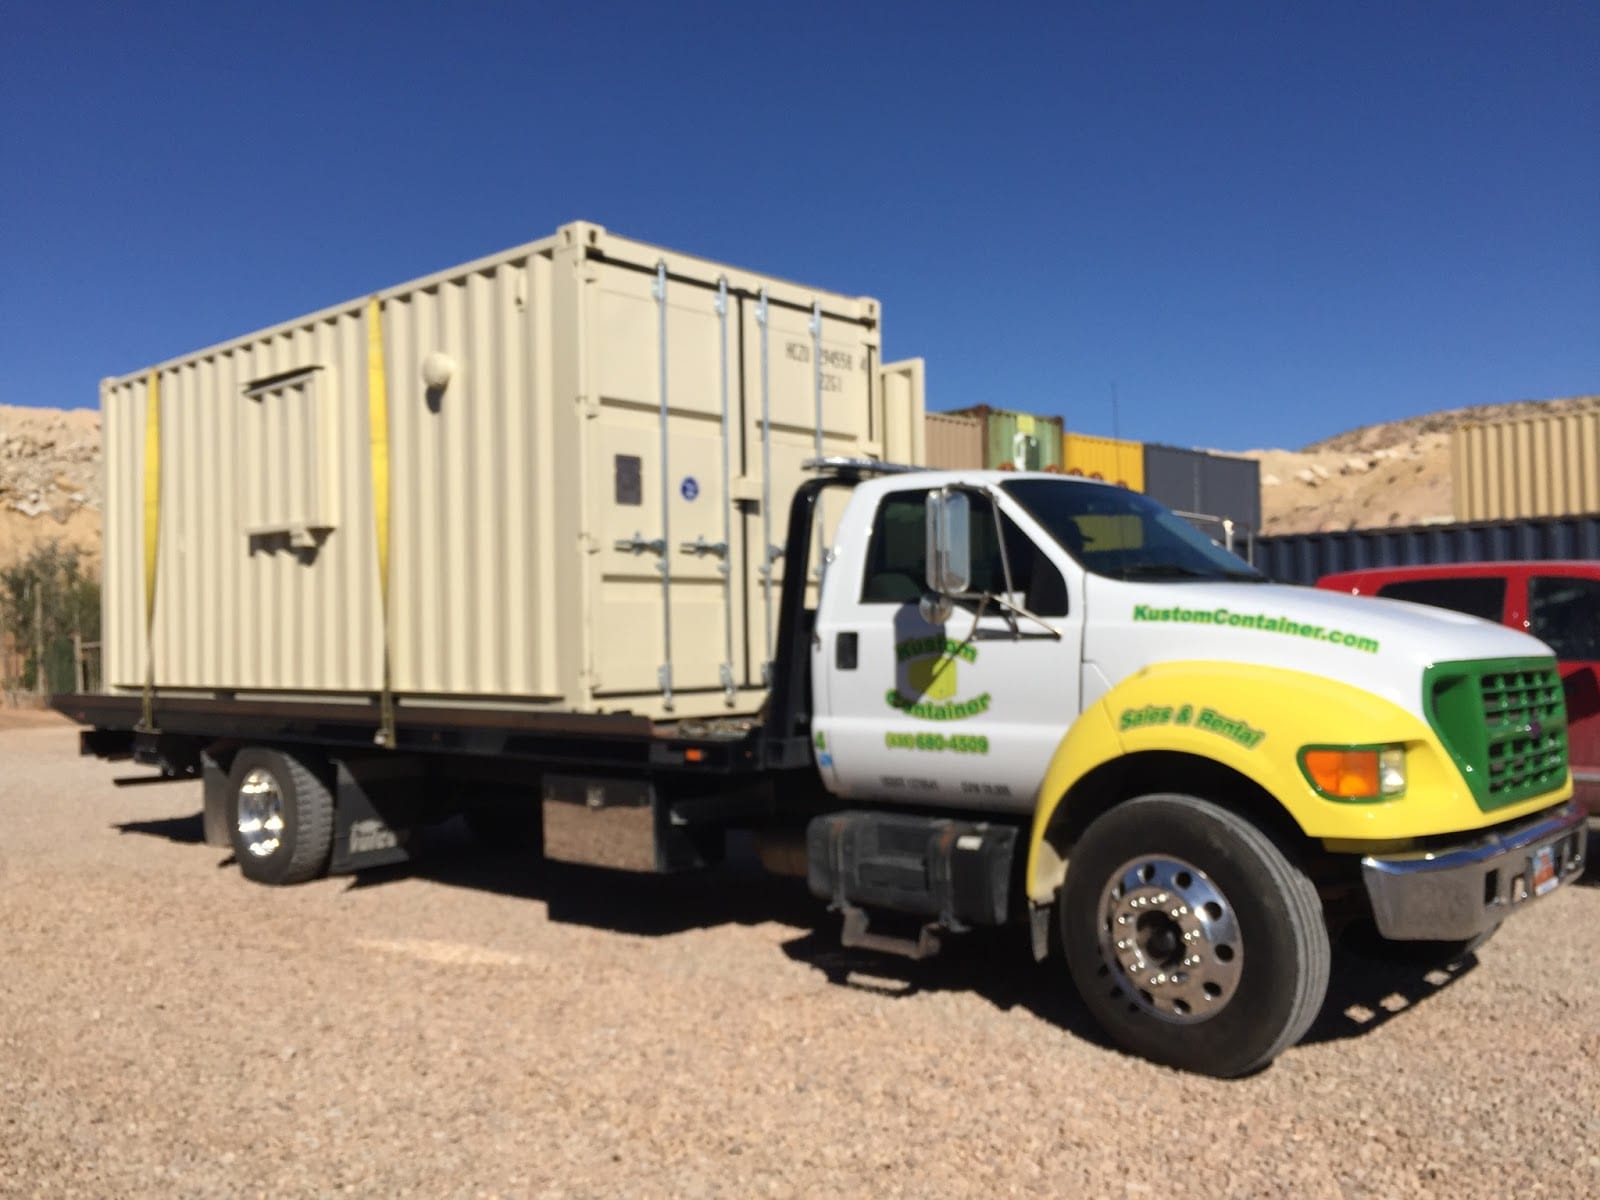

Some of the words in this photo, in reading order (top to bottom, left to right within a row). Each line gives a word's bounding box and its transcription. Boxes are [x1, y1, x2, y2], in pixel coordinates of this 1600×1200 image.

[1133, 604, 1380, 653] KustomContainer.com
[896, 637, 976, 662] Kustom
[885, 690, 990, 720] Container
[1119, 705, 1173, 731] Sales
[1175, 704, 1193, 725] &
[1194, 707, 1265, 749] Rental
